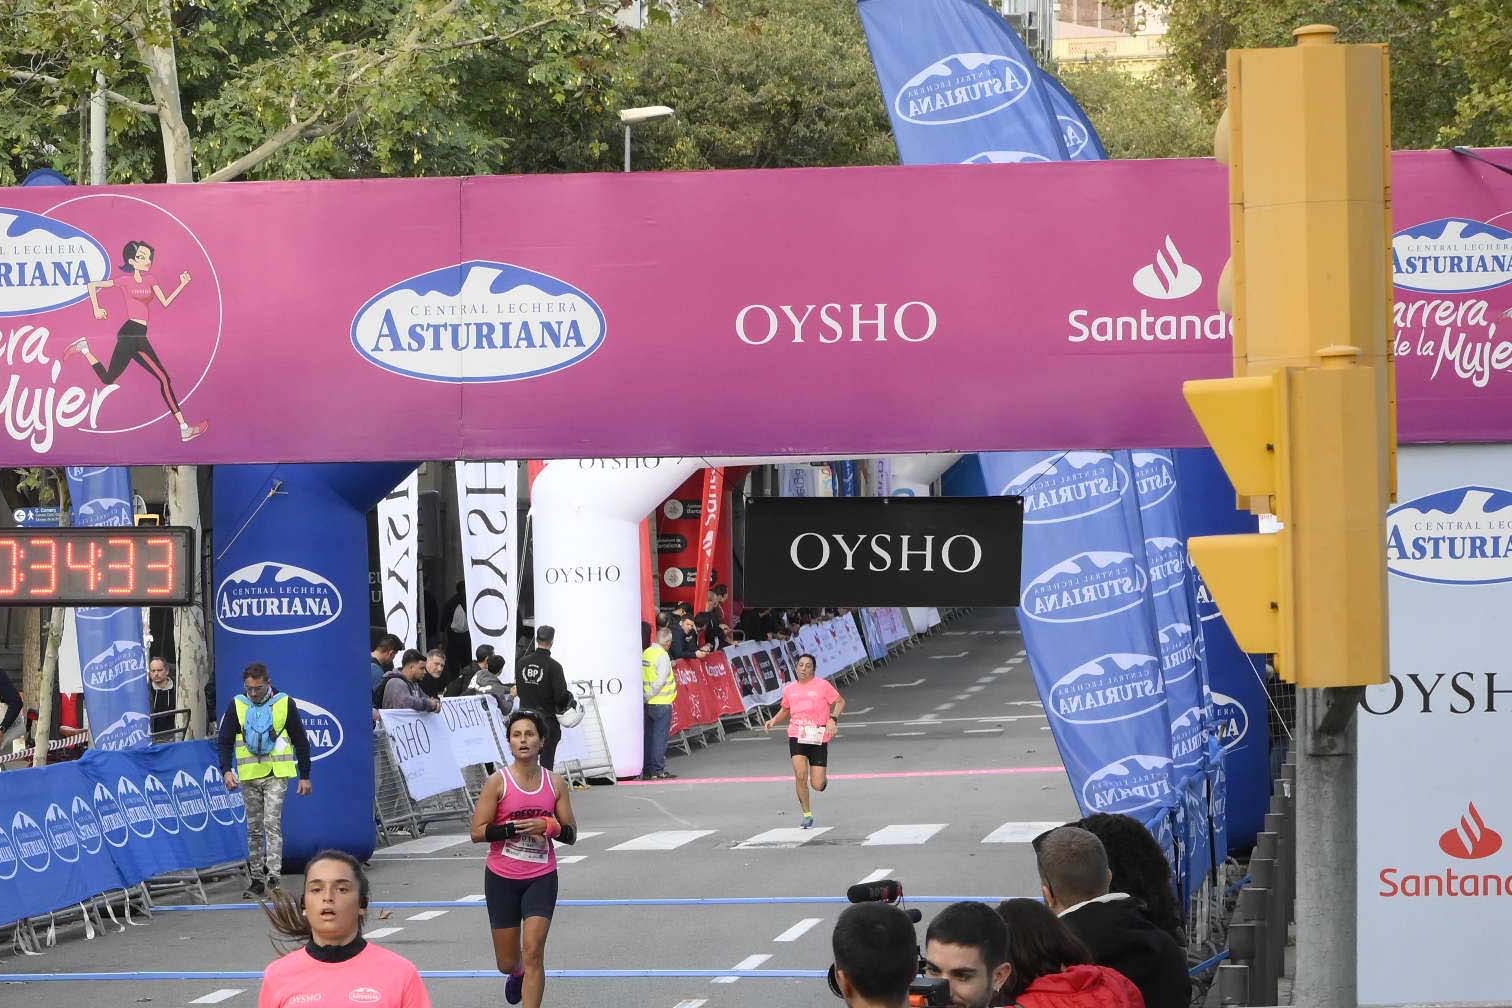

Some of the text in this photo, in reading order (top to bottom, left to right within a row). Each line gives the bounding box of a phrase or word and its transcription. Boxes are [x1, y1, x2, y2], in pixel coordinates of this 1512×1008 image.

[12, 243, 87, 256] LECHERA
[1407, 243, 1459, 252] CENTRAL
[409, 300, 578, 317] CENTRAL LECHERA
[1394, 298, 1489, 328] arrera
[372, 307, 586, 354] ASTURIANA
[735, 301, 938, 345] OYSHO
[1068, 308, 1234, 343] Santand
[1416, 326, 1434, 356] la
[1430, 326, 1512, 388] Muje
[1414, 520, 1481, 531] CENTRAL
[789, 532, 983, 573] OYSHO
[545, 564, 622, 586] OYSHO
[232, 586, 328, 595] CENTRAL LECHERA
[220, 591, 333, 619] ASTURIANA
[527, 668, 539, 678] BP
[1358, 671, 1512, 716] OYSH
